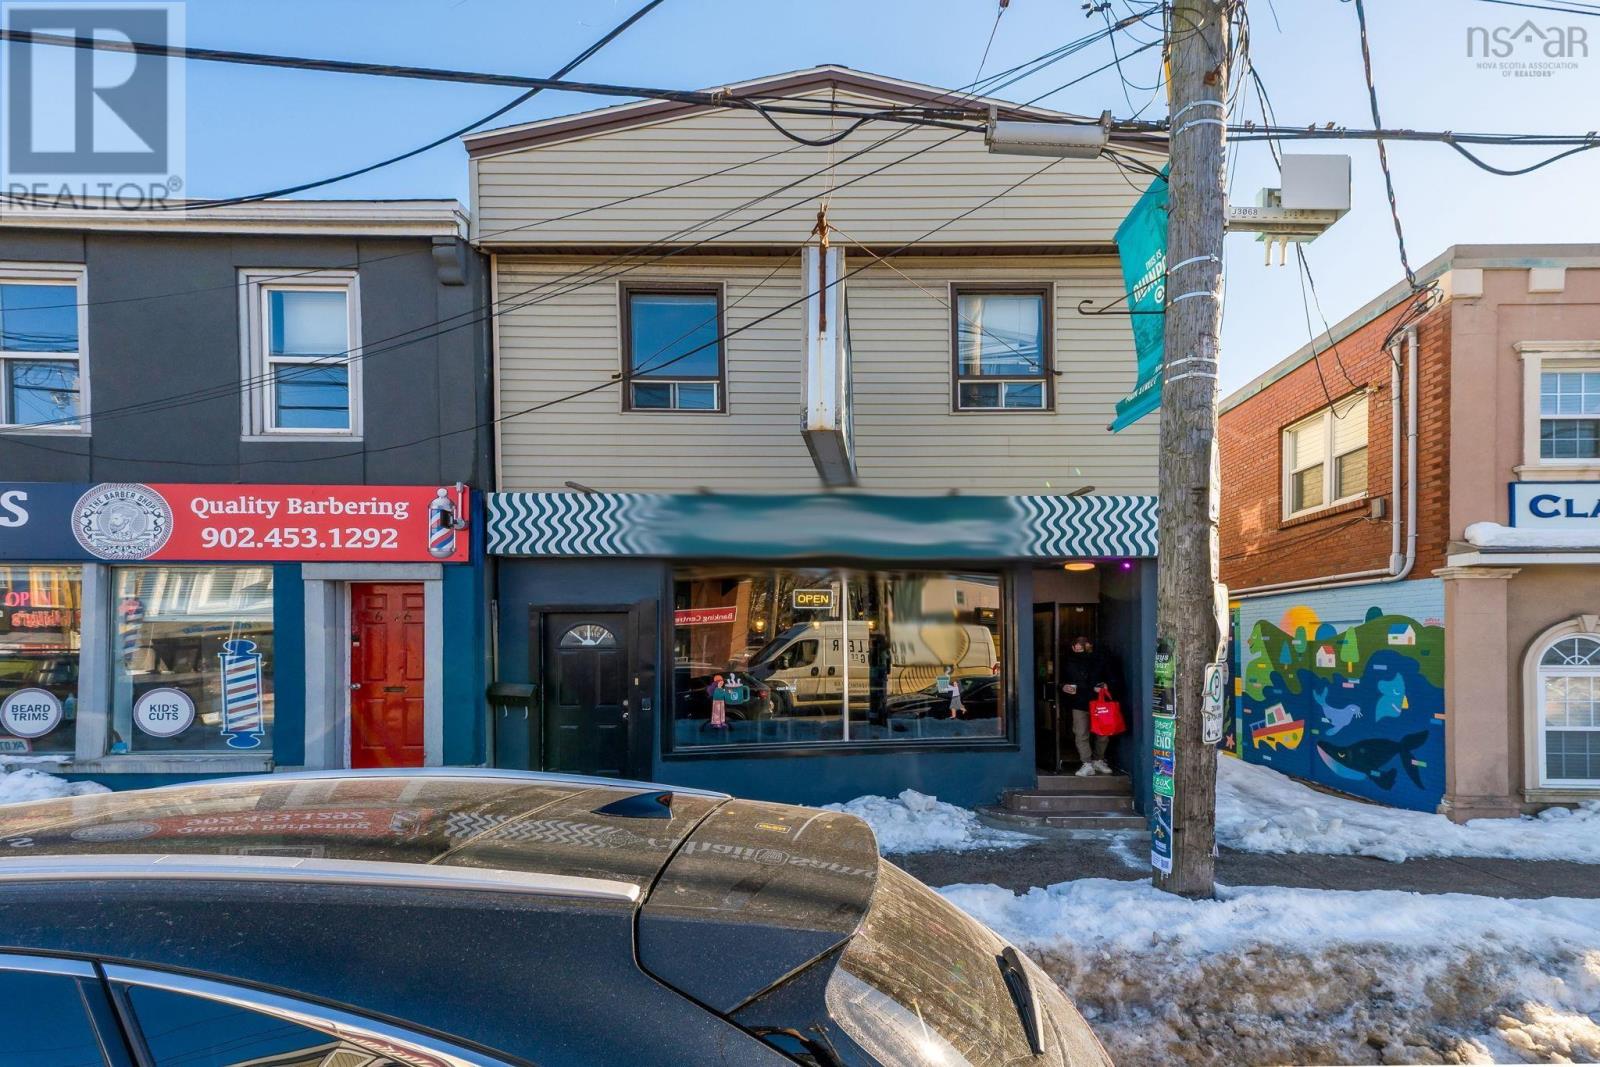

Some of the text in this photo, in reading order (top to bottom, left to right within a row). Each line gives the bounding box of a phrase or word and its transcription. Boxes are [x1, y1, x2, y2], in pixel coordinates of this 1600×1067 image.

[89, 490, 156, 510] THE BARBER SHOP
[190, 496, 409, 520] Quality Barbering
[201, 527, 398, 549] 902.453.1292
[797, 594, 829, 604] OPEN
[11, 704, 51, 713] BEARD
[149, 704, 179, 713] KID'S
[12, 712, 49, 721] TRIMS
[148, 712, 179, 721] CUTS
